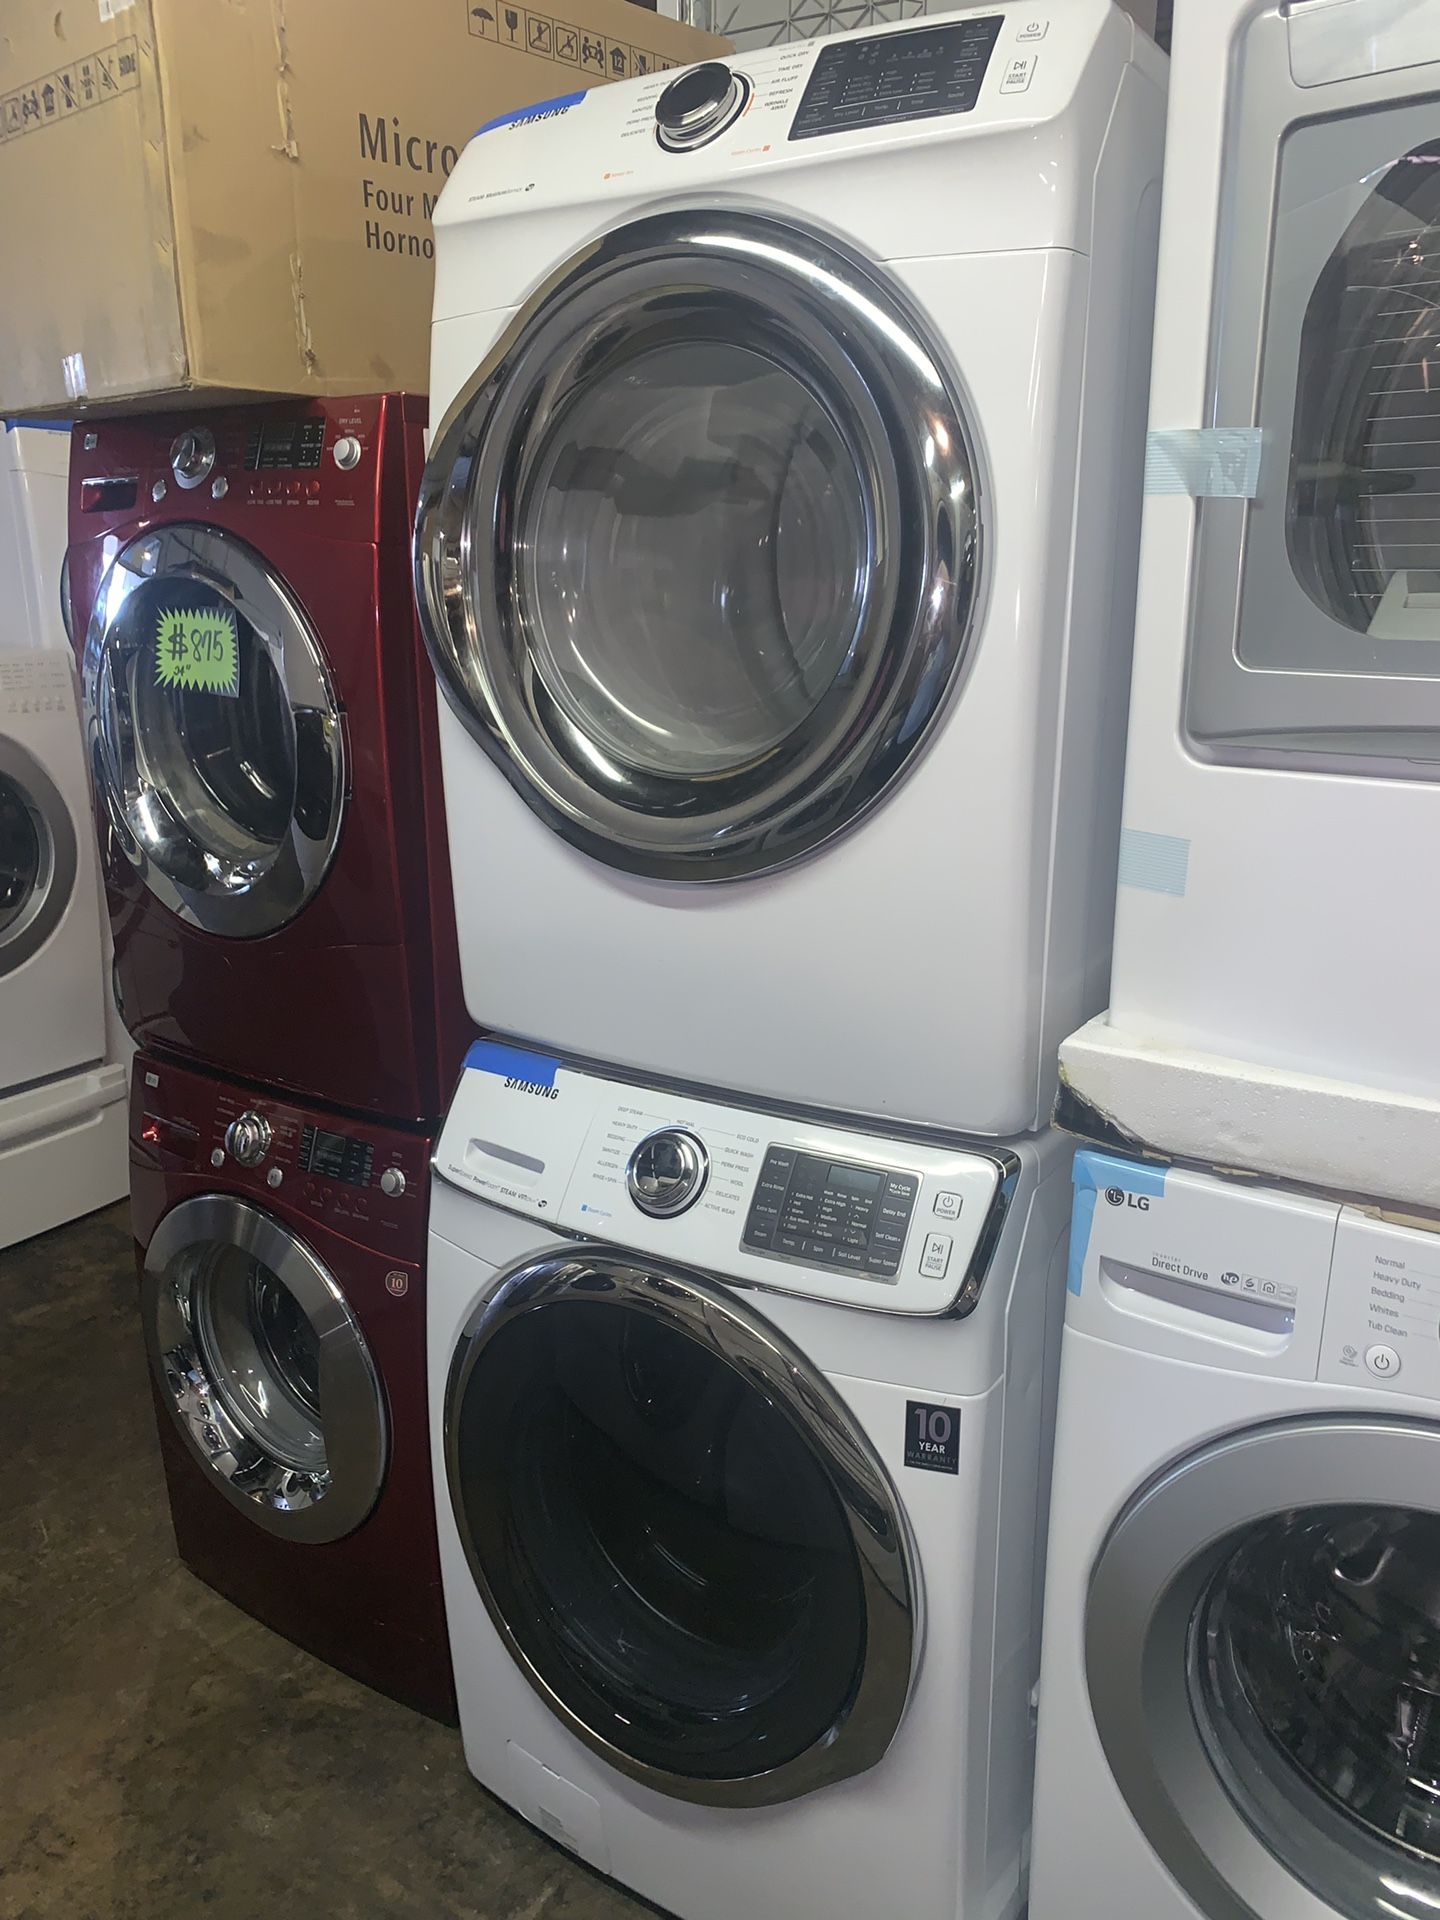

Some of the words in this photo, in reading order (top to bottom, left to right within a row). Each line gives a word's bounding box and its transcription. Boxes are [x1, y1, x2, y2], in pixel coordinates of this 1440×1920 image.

[508, 105, 571, 131] SAMSUNG
[359, 113, 461, 178] Micro
[363, 179, 414, 217] Four
[365, 220, 434, 259] Horno
[504, 1076, 560, 1100] SAMSUNG
[890, 1182, 898, 1190] My
[898, 1184, 911, 1192] Cycle
[936, 1207, 956, 1215] POWER
[1127, 1192, 1150, 1211] LG
[882, 1208, 896, 1216] Delay
[927, 1255, 943, 1263] START
[1151, 1256, 1181, 1274] Direct
[1182, 1265, 1209, 1281] Drive
[1374, 1255, 1406, 1270] Normal
[391, 1278, 403, 1289] 10
[1373, 1271, 1400, 1286] Heavy
[1400, 1277, 1421, 1290] Duty
[1371, 1286, 1405, 1304] Bedding
[1369, 1303, 1399, 1318] Whites
[1368, 1319, 1383, 1331] Tub
[1384, 1324, 1408, 1338] Clean
[914, 1408, 952, 1444] 10
[918, 1441, 946, 1454] YEAR
